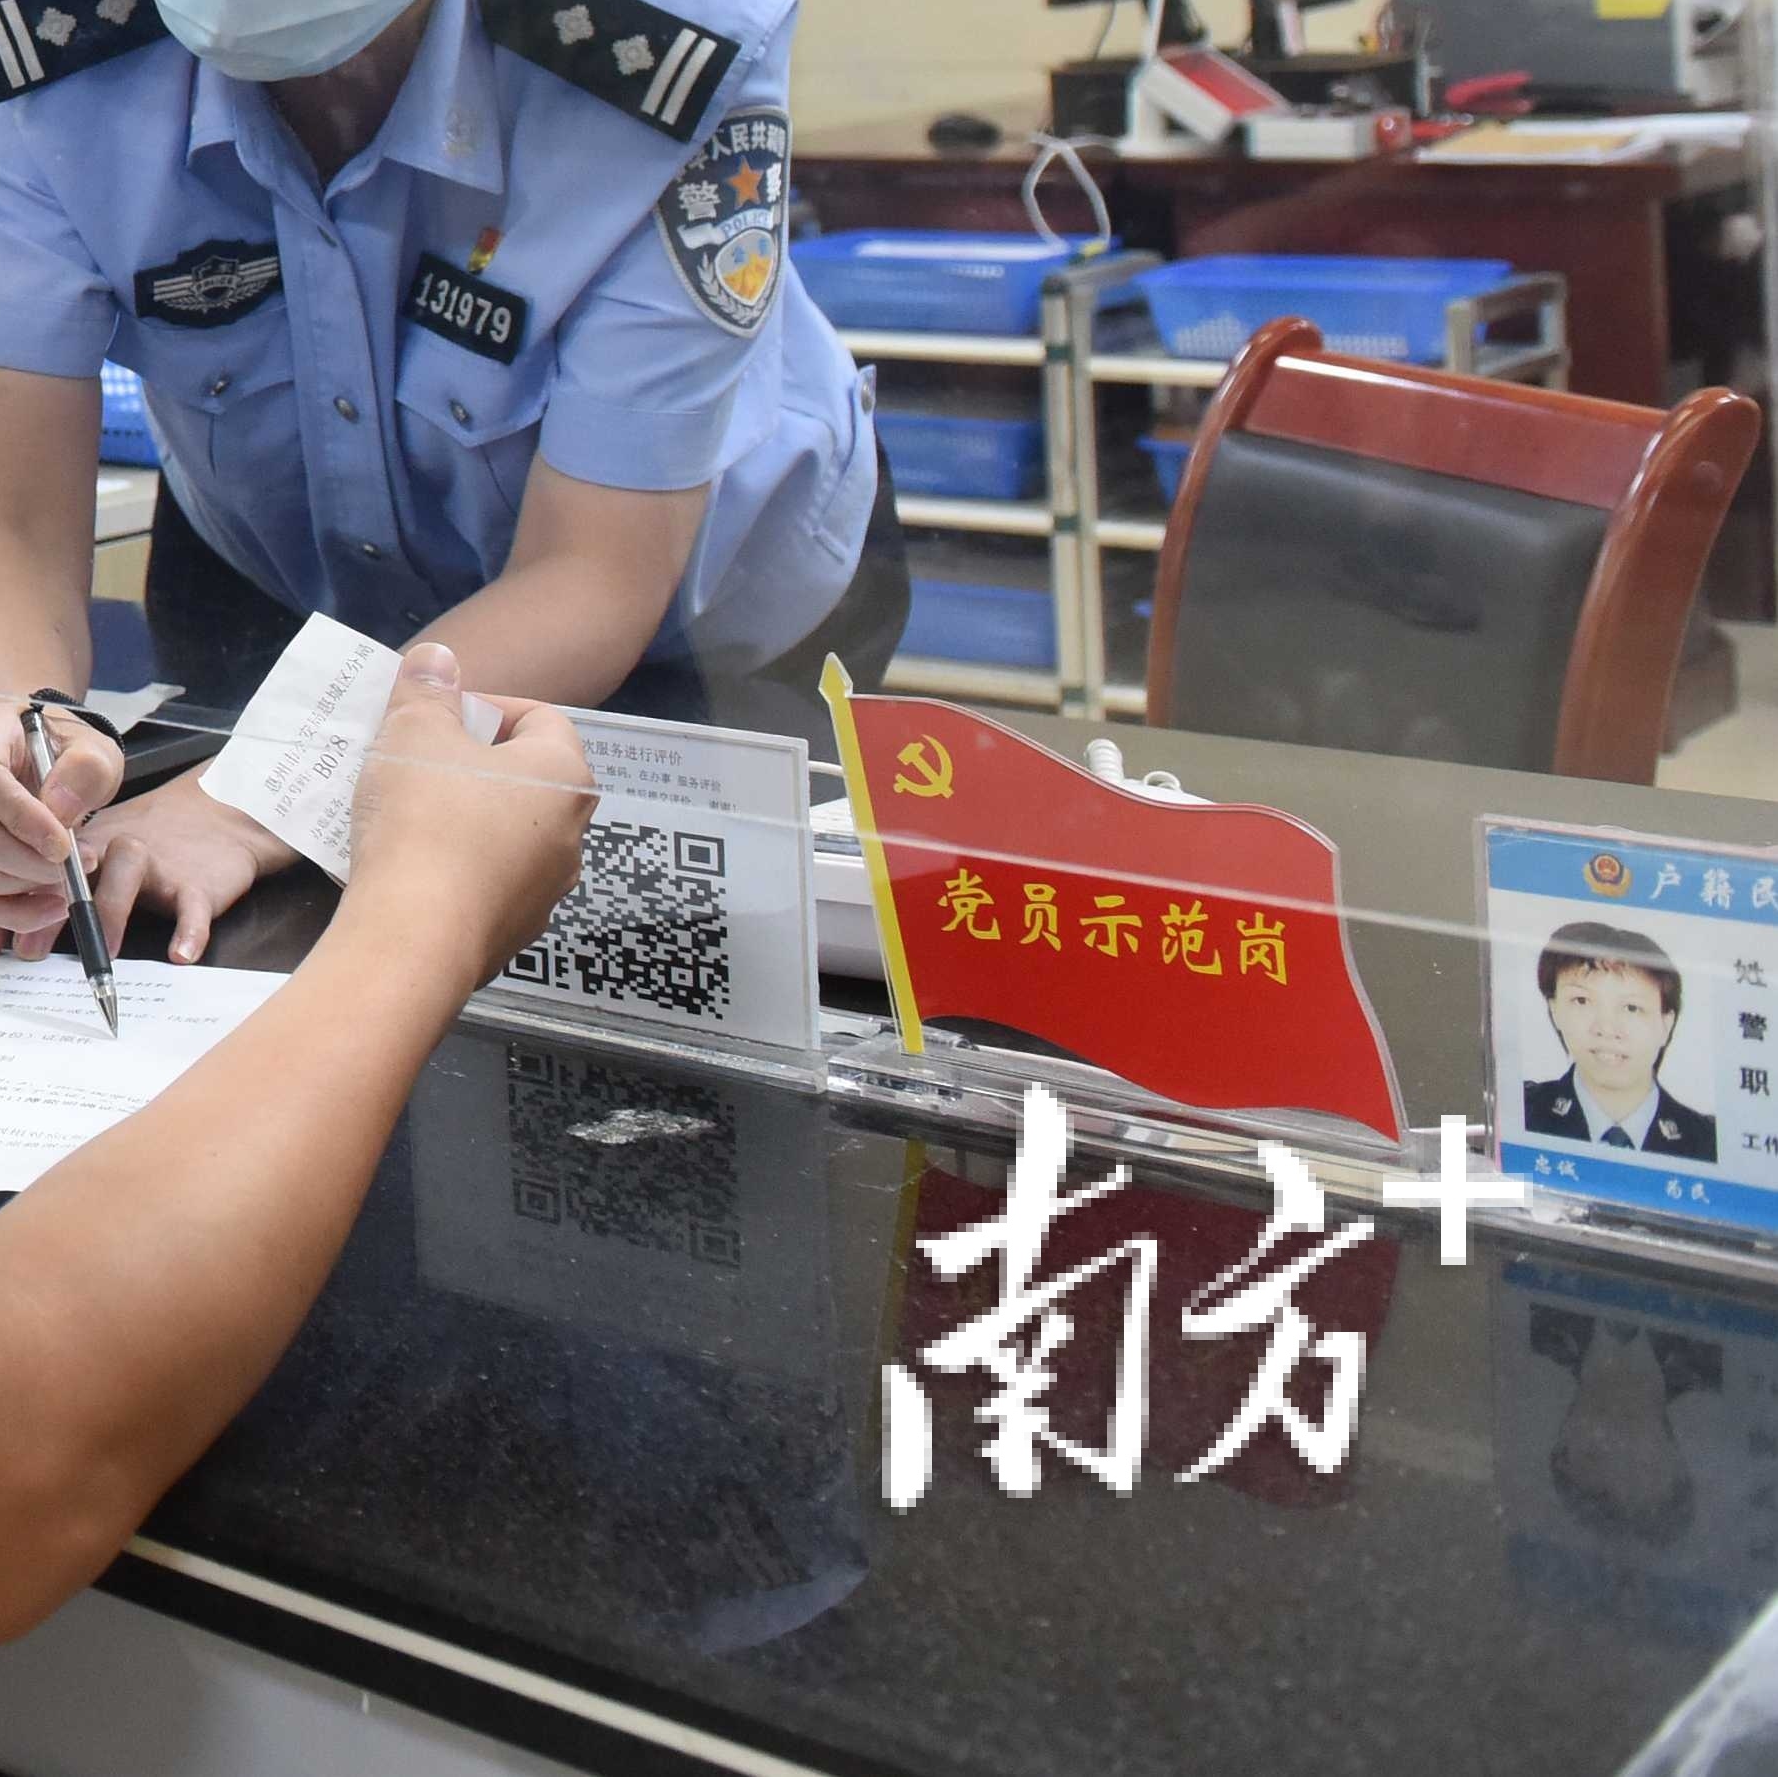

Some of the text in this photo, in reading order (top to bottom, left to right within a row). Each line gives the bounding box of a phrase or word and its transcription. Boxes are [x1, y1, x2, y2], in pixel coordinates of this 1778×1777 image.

[415, 272, 512, 343] 131979
[937, 868, 1290, 986] 党员示范岗
[1734, 958, 1768, 989] 姓
[1738, 1010, 1768, 1042] 警
[1739, 1067, 1770, 1097] 职
